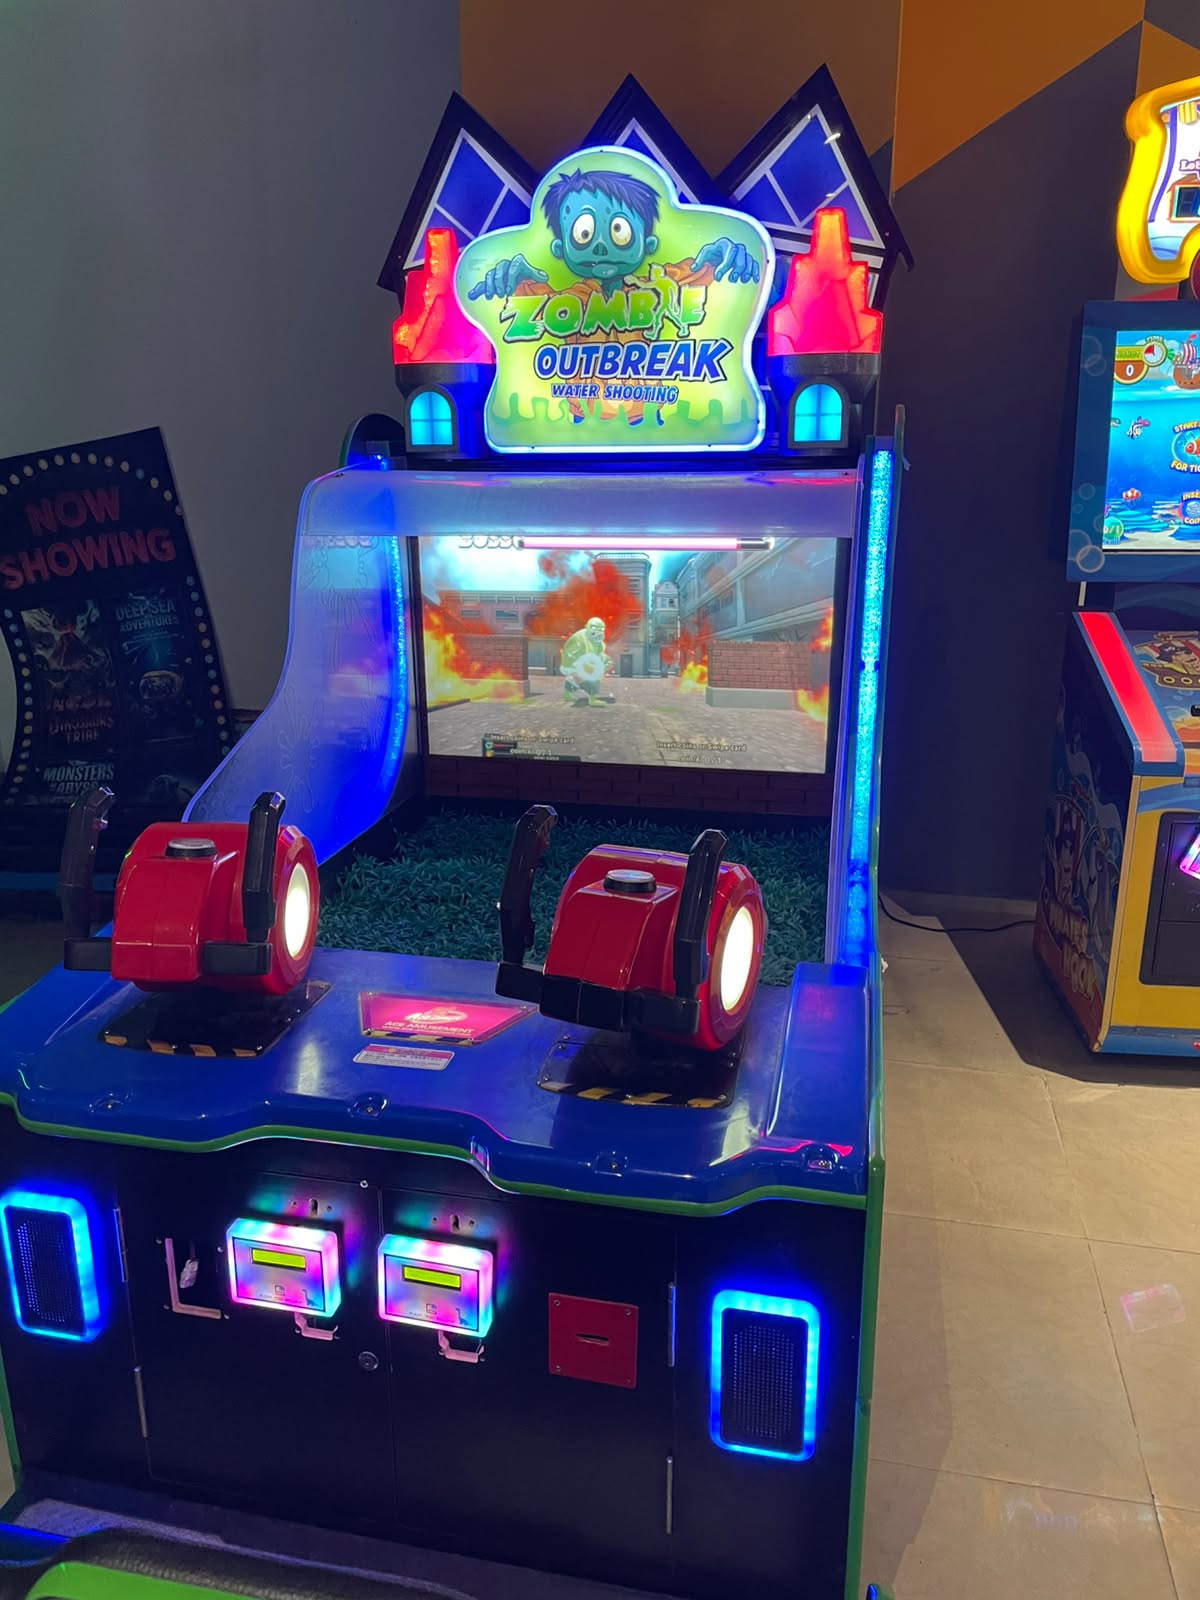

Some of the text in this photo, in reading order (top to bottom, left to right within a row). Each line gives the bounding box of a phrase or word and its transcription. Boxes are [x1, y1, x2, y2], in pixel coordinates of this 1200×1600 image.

[500, 266, 707, 344] ZOMBIE
[1145, 336, 1164, 344] TIME
[534, 338, 733, 383] OUTBREAK
[1126, 364, 1134, 377] 0
[552, 384, 679, 404] WATER SHOOTING
[1171, 458, 1187, 472] FOR
[25, 486, 121, 536] NOW
[0, 528, 176, 591] SHOWING
[115, 599, 177, 622] DEEP SEA
[119, 615, 180, 632] ADVENTURES
[656, 740, 678, 749] Insert
[678, 741, 697, 750] coins
[706, 743, 729, 752] Swipe
[729, 743, 747, 752] card
[43, 761, 114, 783] MONSTERS
[384, 1020, 406, 1028] ACE
[406, 1023, 475, 1035] AMUSEMENT
